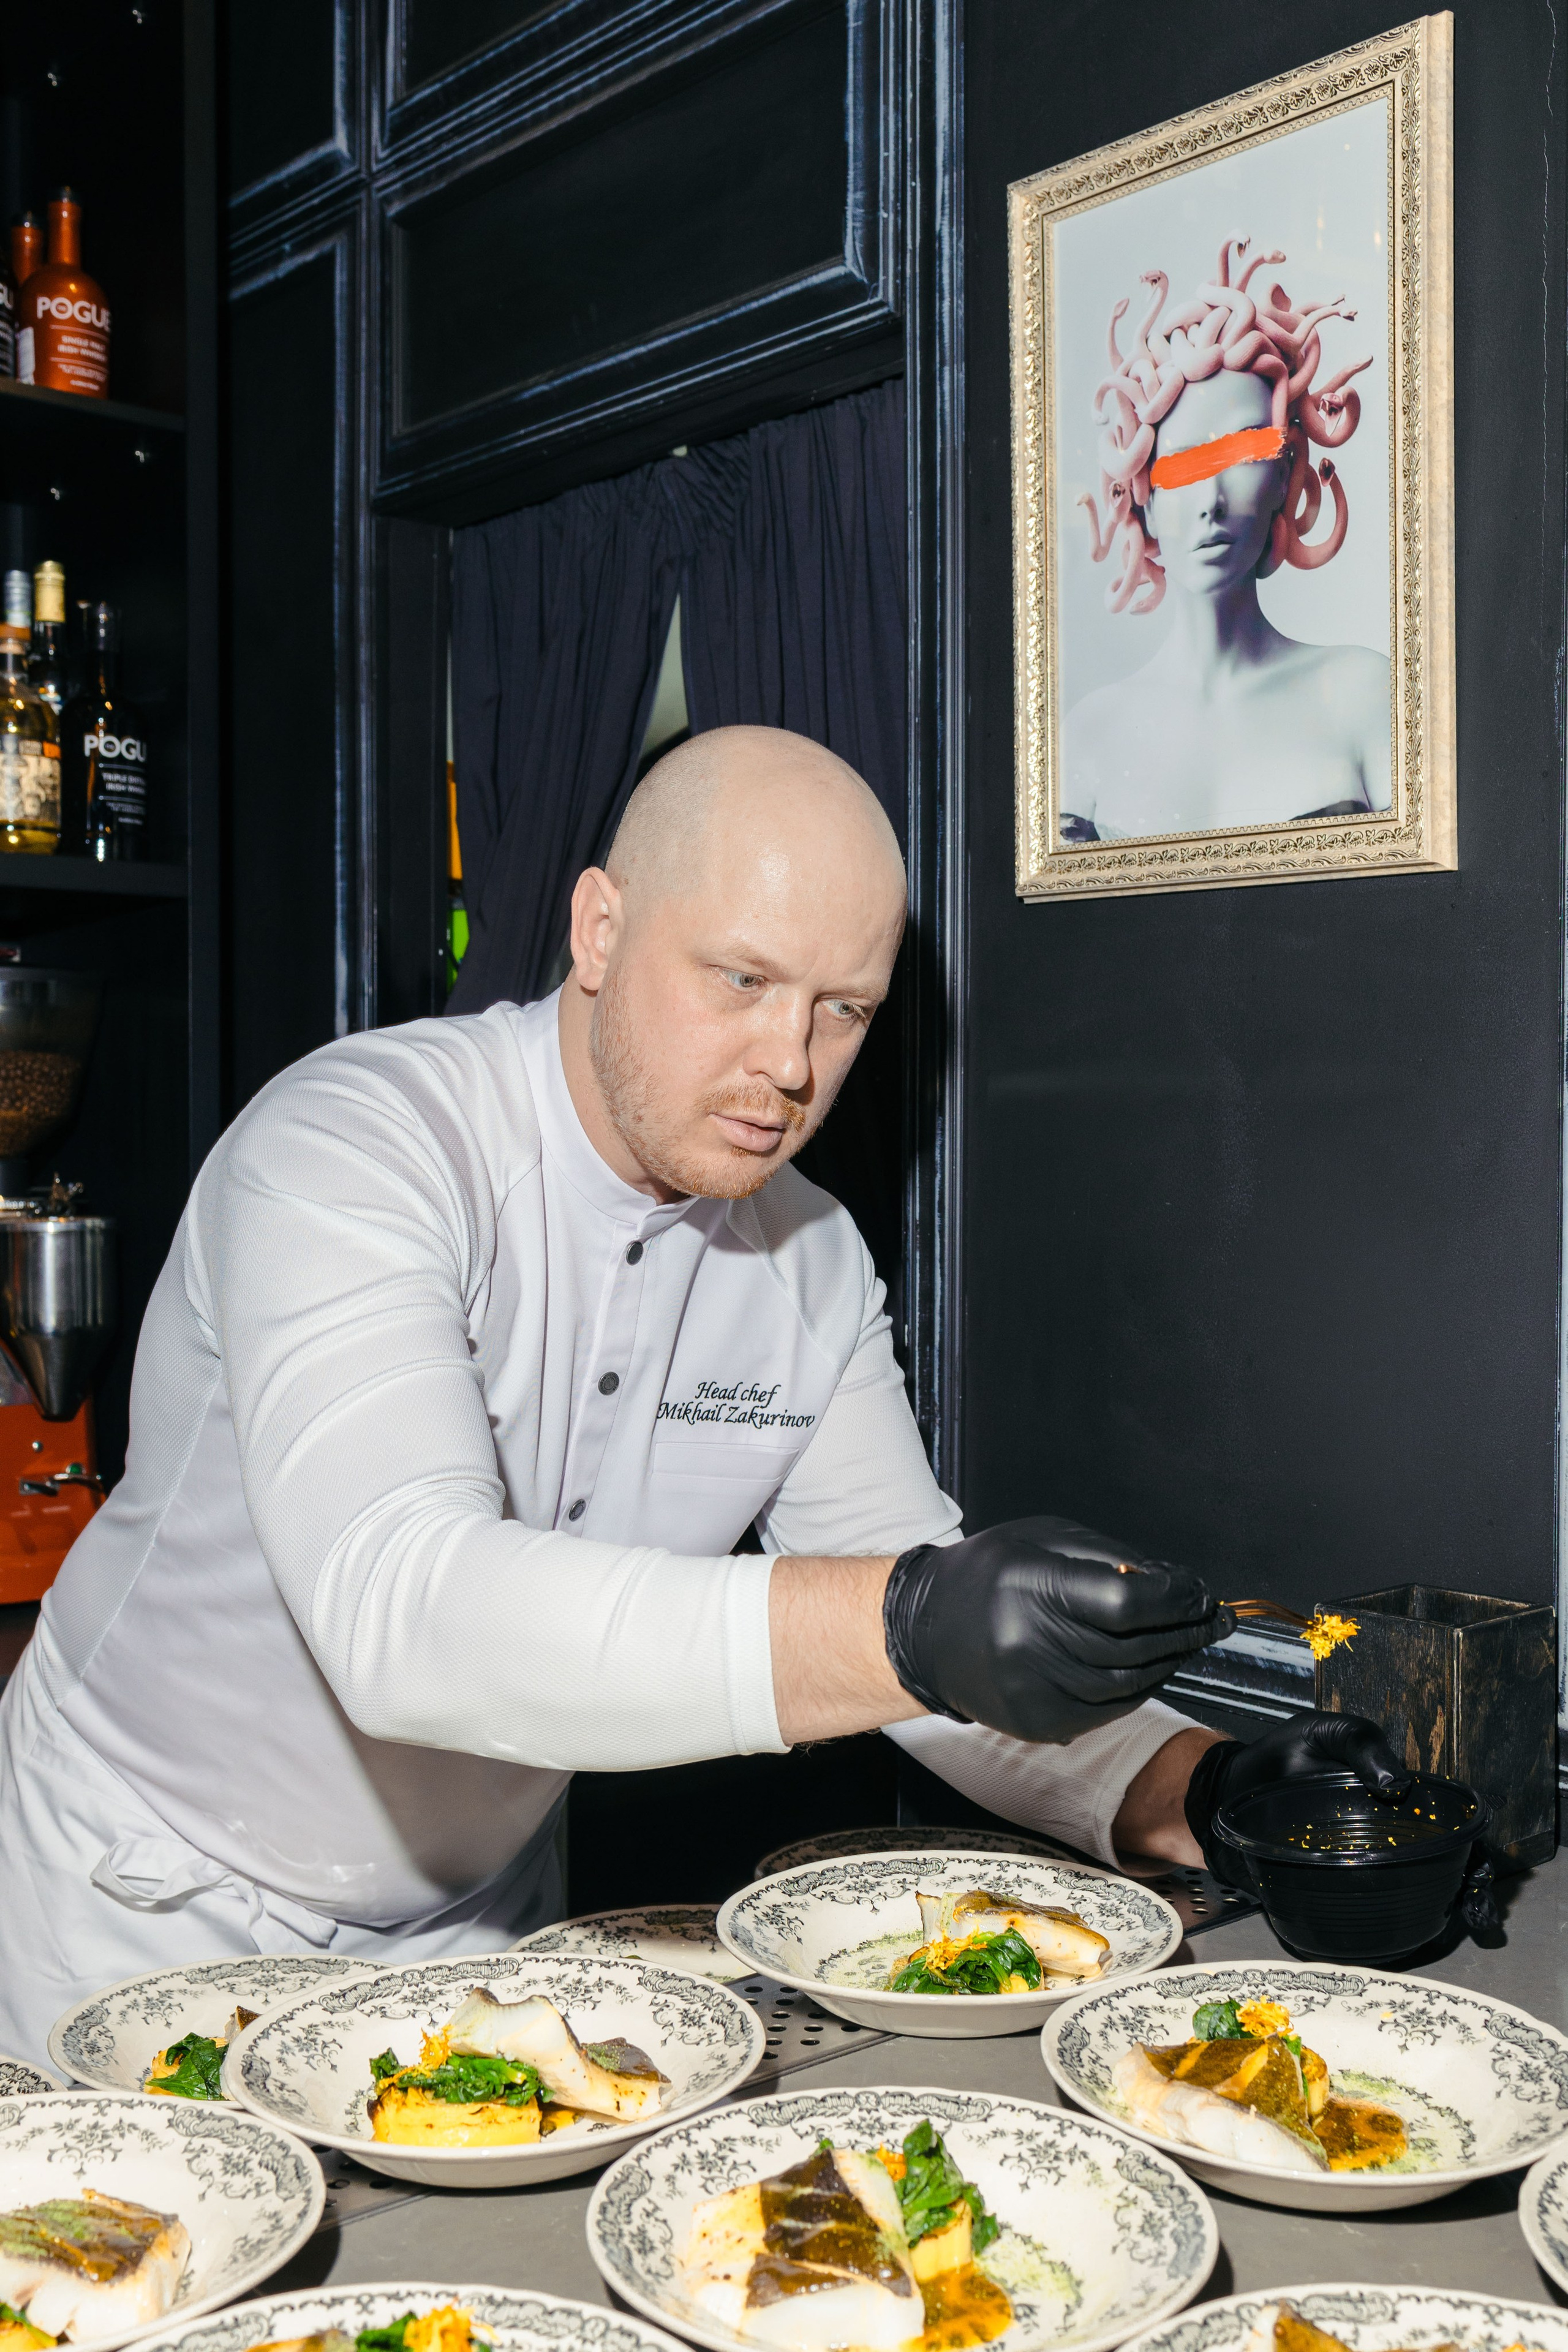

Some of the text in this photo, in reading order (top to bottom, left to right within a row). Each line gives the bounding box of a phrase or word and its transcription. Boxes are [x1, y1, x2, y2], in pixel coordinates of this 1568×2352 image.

[695, 1382, 782, 1408] Head chef
[656, 1401, 815, 1429] Mikhail Zakurinov
